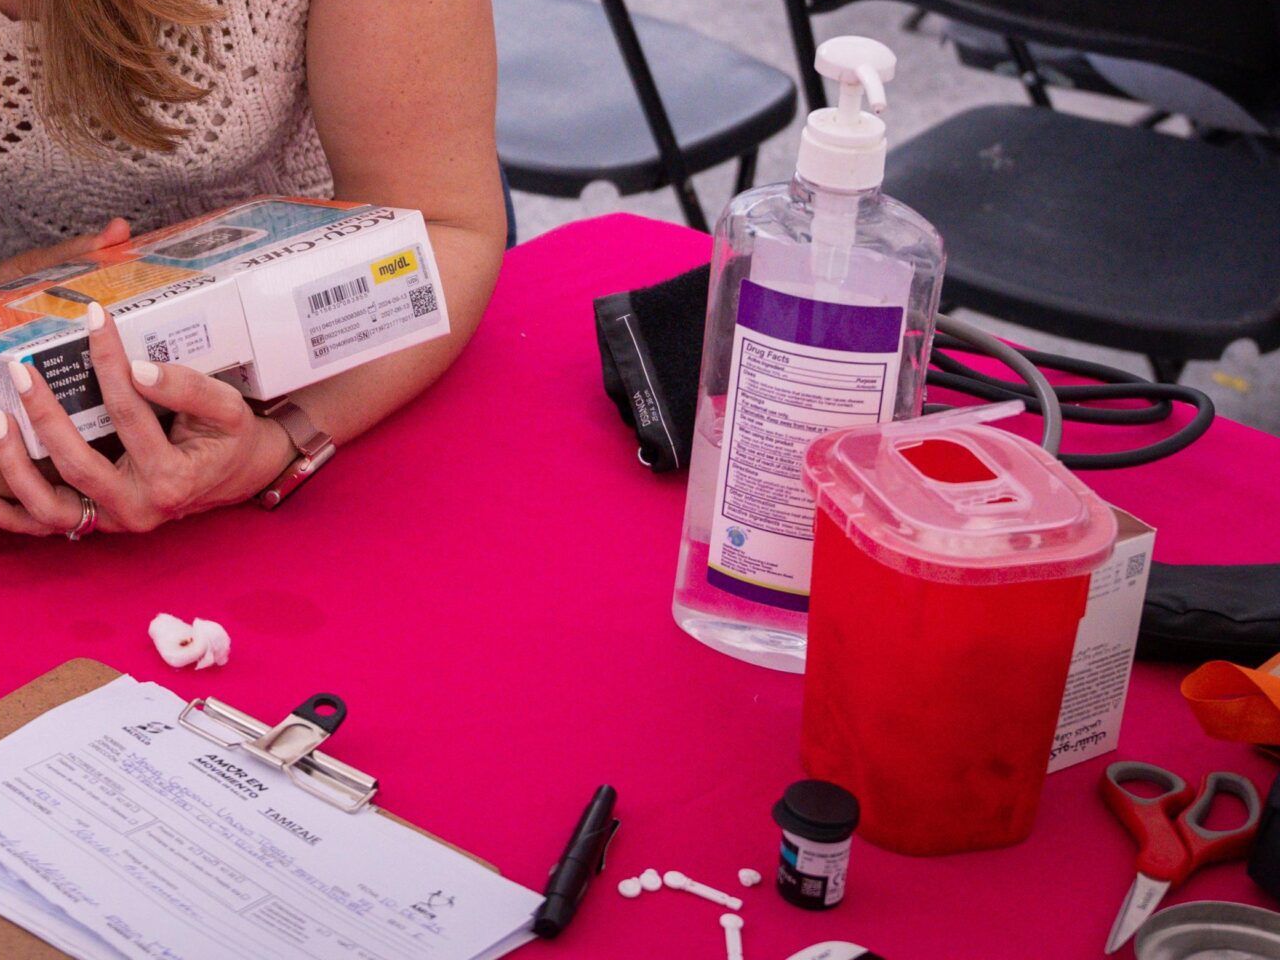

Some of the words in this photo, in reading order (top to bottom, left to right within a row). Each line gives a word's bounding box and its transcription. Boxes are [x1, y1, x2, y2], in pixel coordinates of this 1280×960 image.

[377, 254, 411, 278] mg/dL
[109, 276, 217, 317] ACCU-CHE
[745, 343, 766, 359] Drug
[766, 350, 790, 364] Facts
[190, 755, 262, 800] MOVIMIENTO
[243, 776, 271, 793] EN
[260, 805, 324, 845] TAMIZAJE
